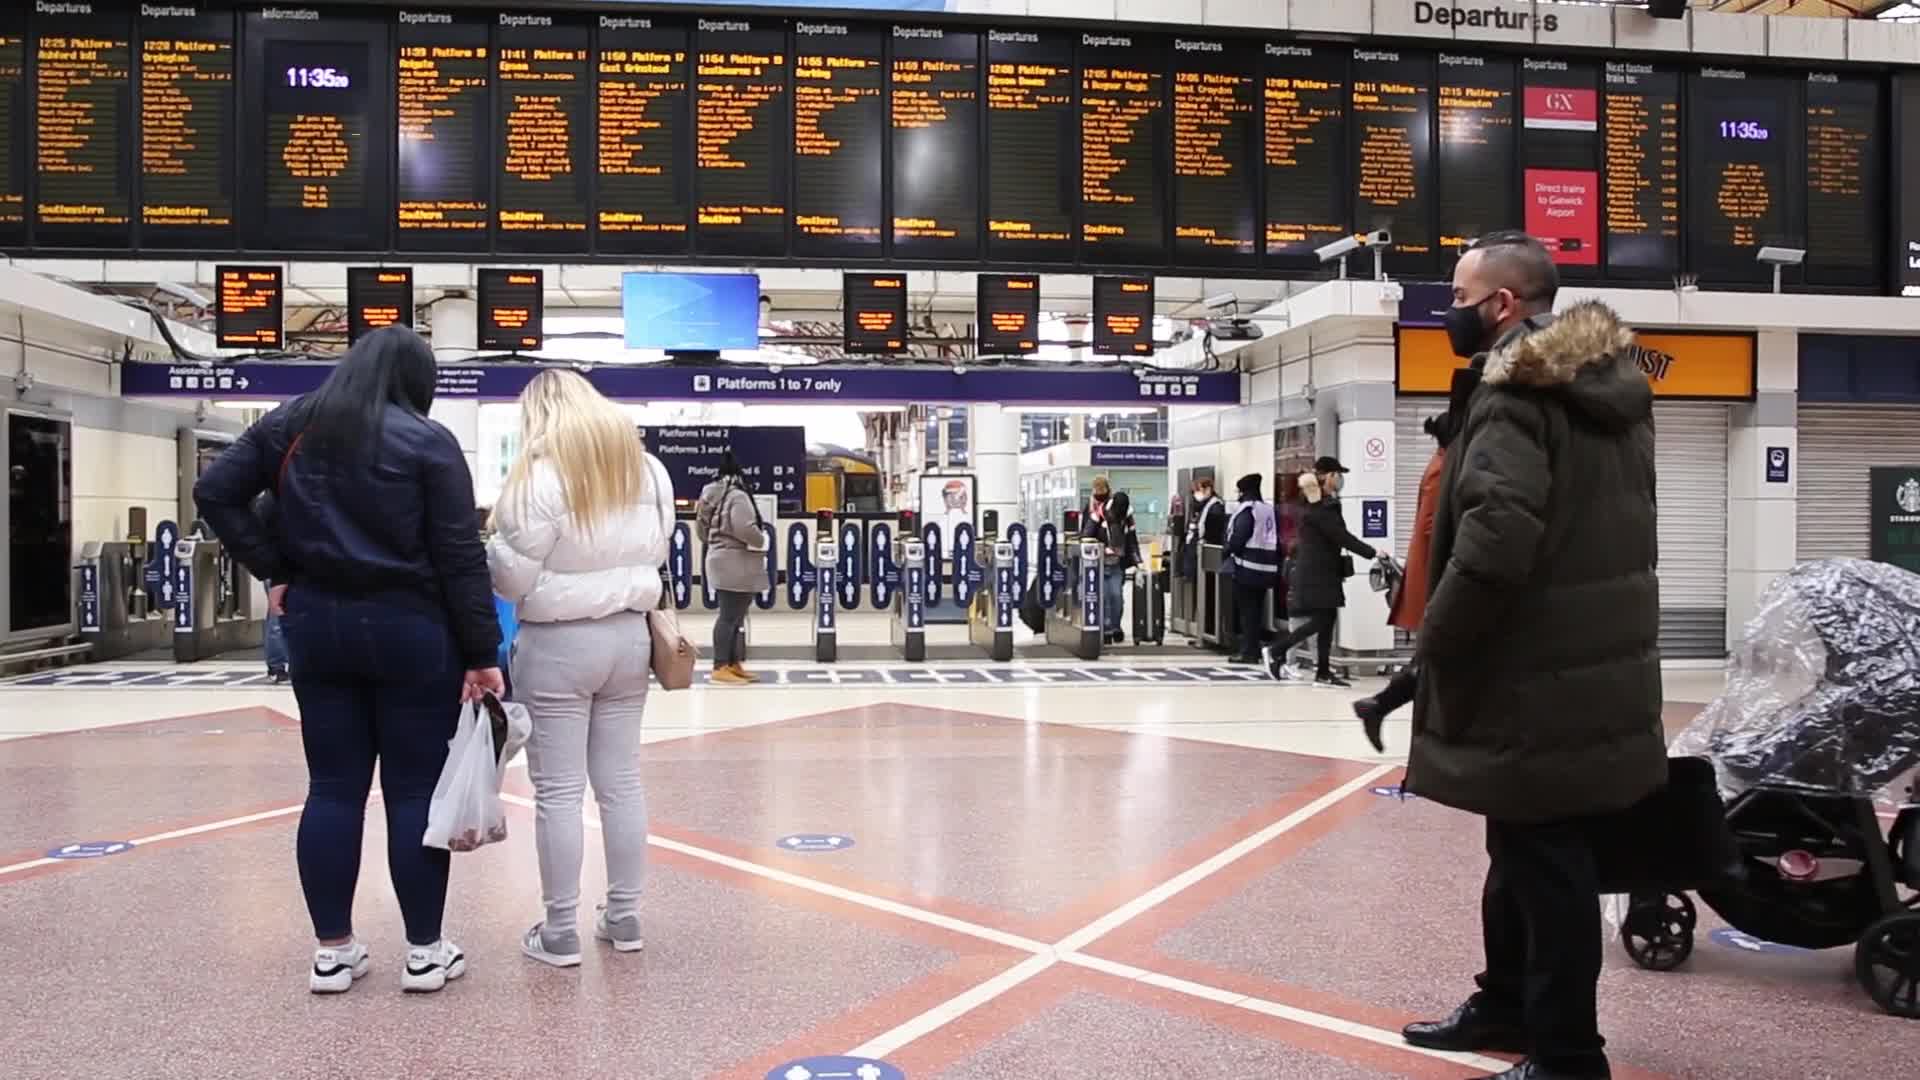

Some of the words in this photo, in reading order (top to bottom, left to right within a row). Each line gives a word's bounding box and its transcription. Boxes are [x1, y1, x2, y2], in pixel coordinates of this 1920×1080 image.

[36, 1, 92, 14] Departures
[141, 4, 196, 17] Departures
[262, 8, 318, 20] Information
[399, 11, 452, 24] Departures
[499, 13, 552, 27] Departures
[600, 16, 651, 30] Departures
[698, 19, 750, 32] Departures
[796, 22, 848, 36] Departures
[893, 26, 943, 39] Departures
[988, 30, 1039, 43] Departures
[70, 39, 112, 48] Platform
[1082, 34, 1131, 47] Departures
[1175, 39, 1223, 52] Departures
[175, 42, 215, 51] Platform
[1265, 43, 1312, 56] Departures
[432, 48, 472, 57] Platform
[534, 50, 573, 60] Platform
[632, 53, 671, 62] Platform
[1353, 49, 1399, 62] Departures
[730, 55, 769, 64] Platform
[827, 58, 865, 68] Platform
[1439, 54, 1484, 66] Departures
[923, 62, 960, 71] Platform
[1018, 65, 1056, 75] Platform
[1112, 70, 1148, 79] Platform
[1701, 67, 1745, 79] Information
[1808, 72, 1838, 83] Arrivals
[1203, 74, 1239, 84] Platform
[1293, 79, 1328, 89] Platform
[1380, 84, 1415, 94] Platform
[1466, 88, 1499, 97] Platform
[1546, 93, 1573, 111] GX
[399, 211, 442, 220] Southern
[600, 213, 642, 222] Southern
[698, 215, 742, 224] Southern
[1182, 375, 1199, 385] gate
[716, 379, 776, 391] Platforms
[780, 379, 785, 390] 1
[788, 379, 800, 391] to
[803, 379, 812, 390] 7
[815, 380, 842, 393] only
[658, 446, 698, 454] Platforms
